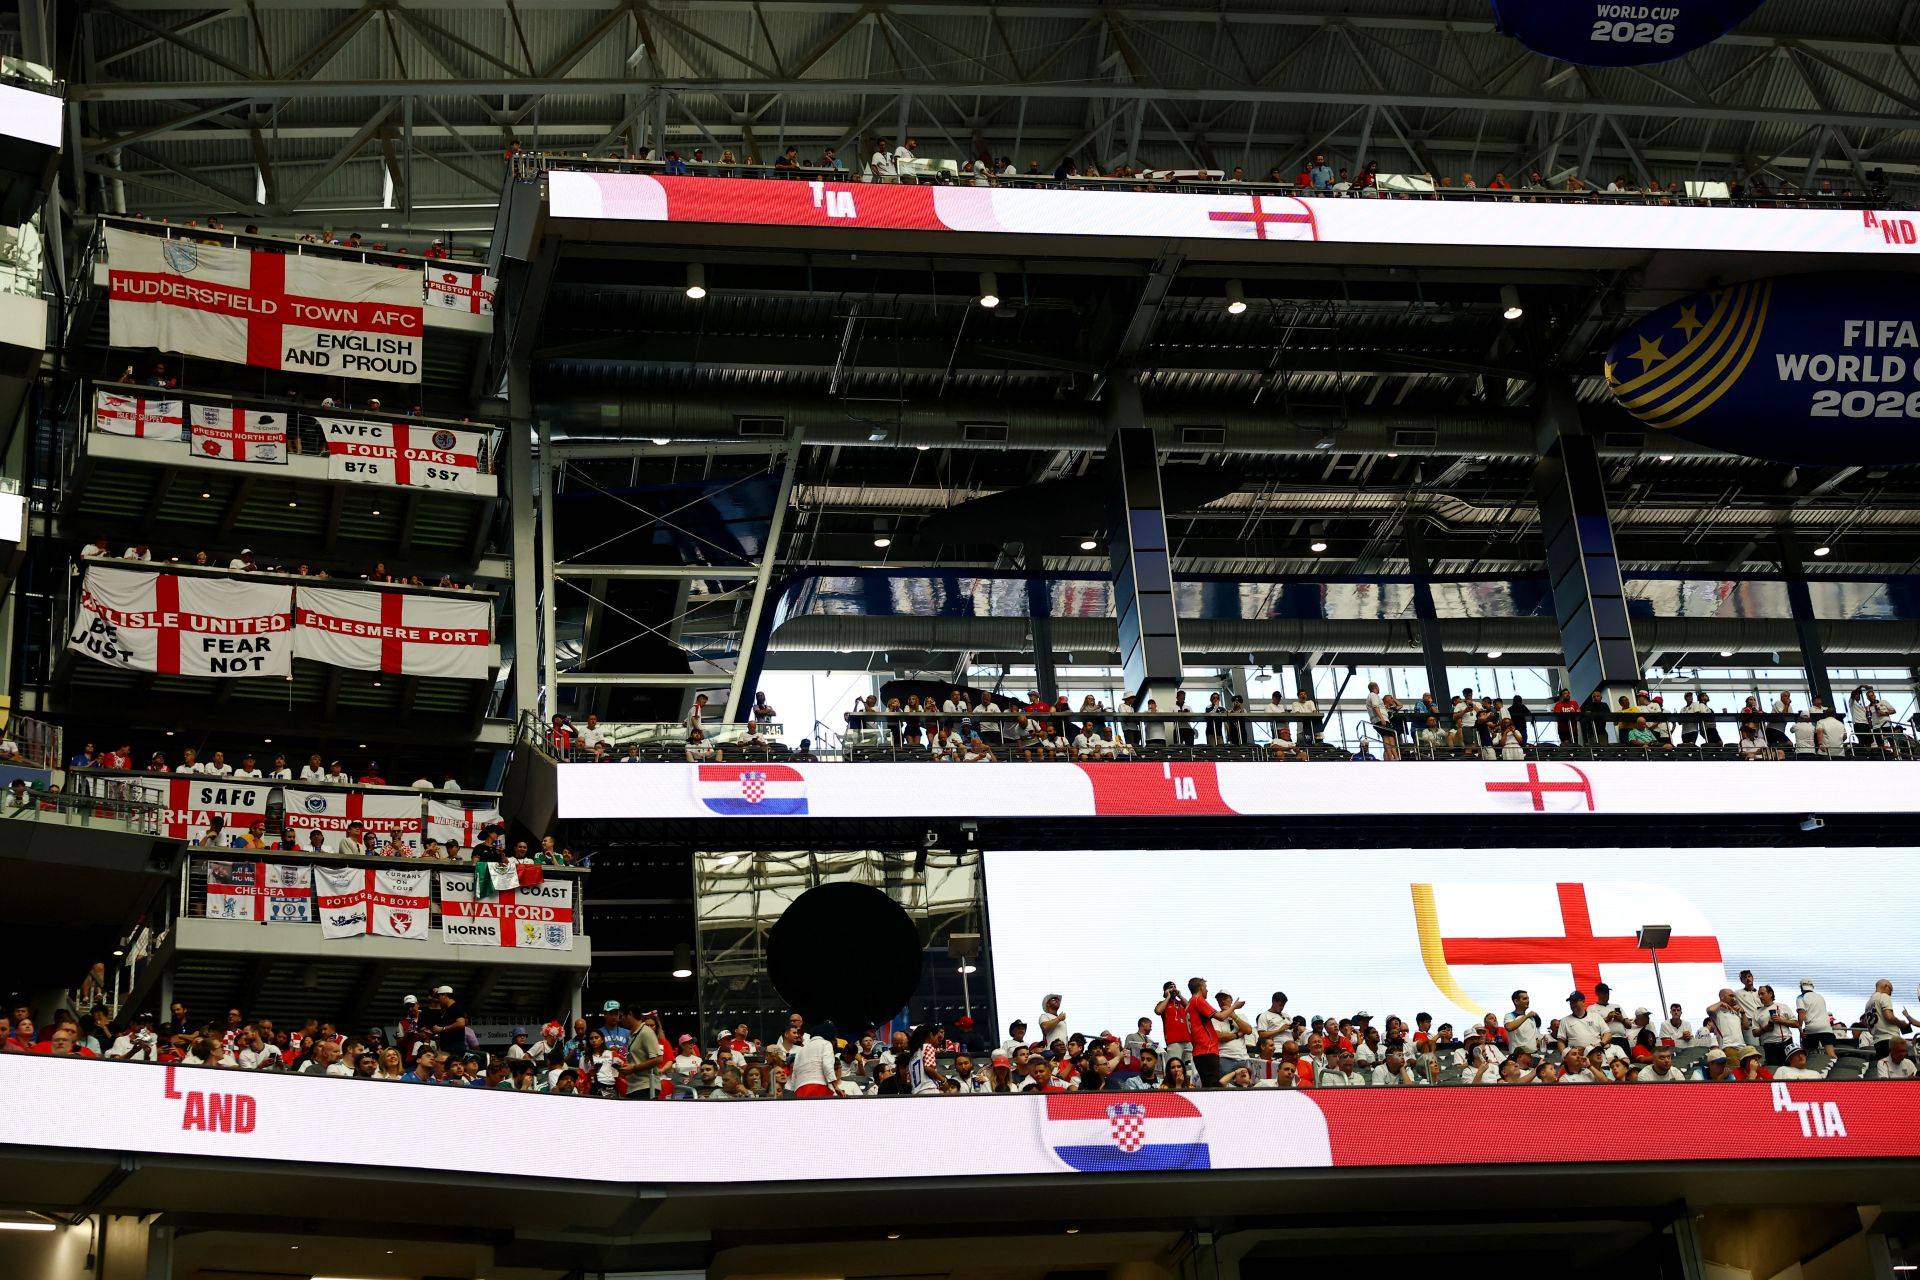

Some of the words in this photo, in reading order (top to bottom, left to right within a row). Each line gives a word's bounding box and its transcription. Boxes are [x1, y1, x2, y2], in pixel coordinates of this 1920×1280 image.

[1597, 5, 1648, 19] WORLD
[1651, 7, 1680, 20] CUP
[1591, 21, 1676, 44] 2026
[430, 282, 470, 295] PRESTON
[112, 277, 278, 314] HUDDERSFIELD
[291, 303, 358, 324] TOWN
[371, 310, 416, 328] AFC
[1844, 320, 1919, 348] FIFA
[317, 333, 412, 356] ENGLISH
[285, 348, 330, 367] AND
[342, 354, 417, 375] PROUD
[1775, 354, 1906, 382] WORLD
[193, 428, 233, 439] PRESTON
[330, 424, 382, 438] AVFC
[347, 443, 397, 458] FOUR
[404, 450, 456, 464] OAKS
[345, 461, 378, 474] B75
[426, 468, 459, 482] SS7
[90, 617, 117, 643] BE
[190, 615, 285, 633] UNITED
[305, 613, 420, 640] ELLESMERE
[429, 631, 479, 643] PORT
[71, 630, 134, 662] JUST
[202, 637, 272, 654] FEAR
[210, 656, 265, 674] NOT
[765, 725, 782, 736] 345
[201, 787, 256, 807] SAFC
[289, 815, 394, 831] PORTSMUTH
[400, 820, 418, 831] FC
[235, 886, 285, 896] CHELSEA
[520, 886, 568, 899] COAST
[390, 897, 418, 906] BOYS
[459, 902, 555, 921] WATFORD
[448, 925, 496, 936] HORNS
